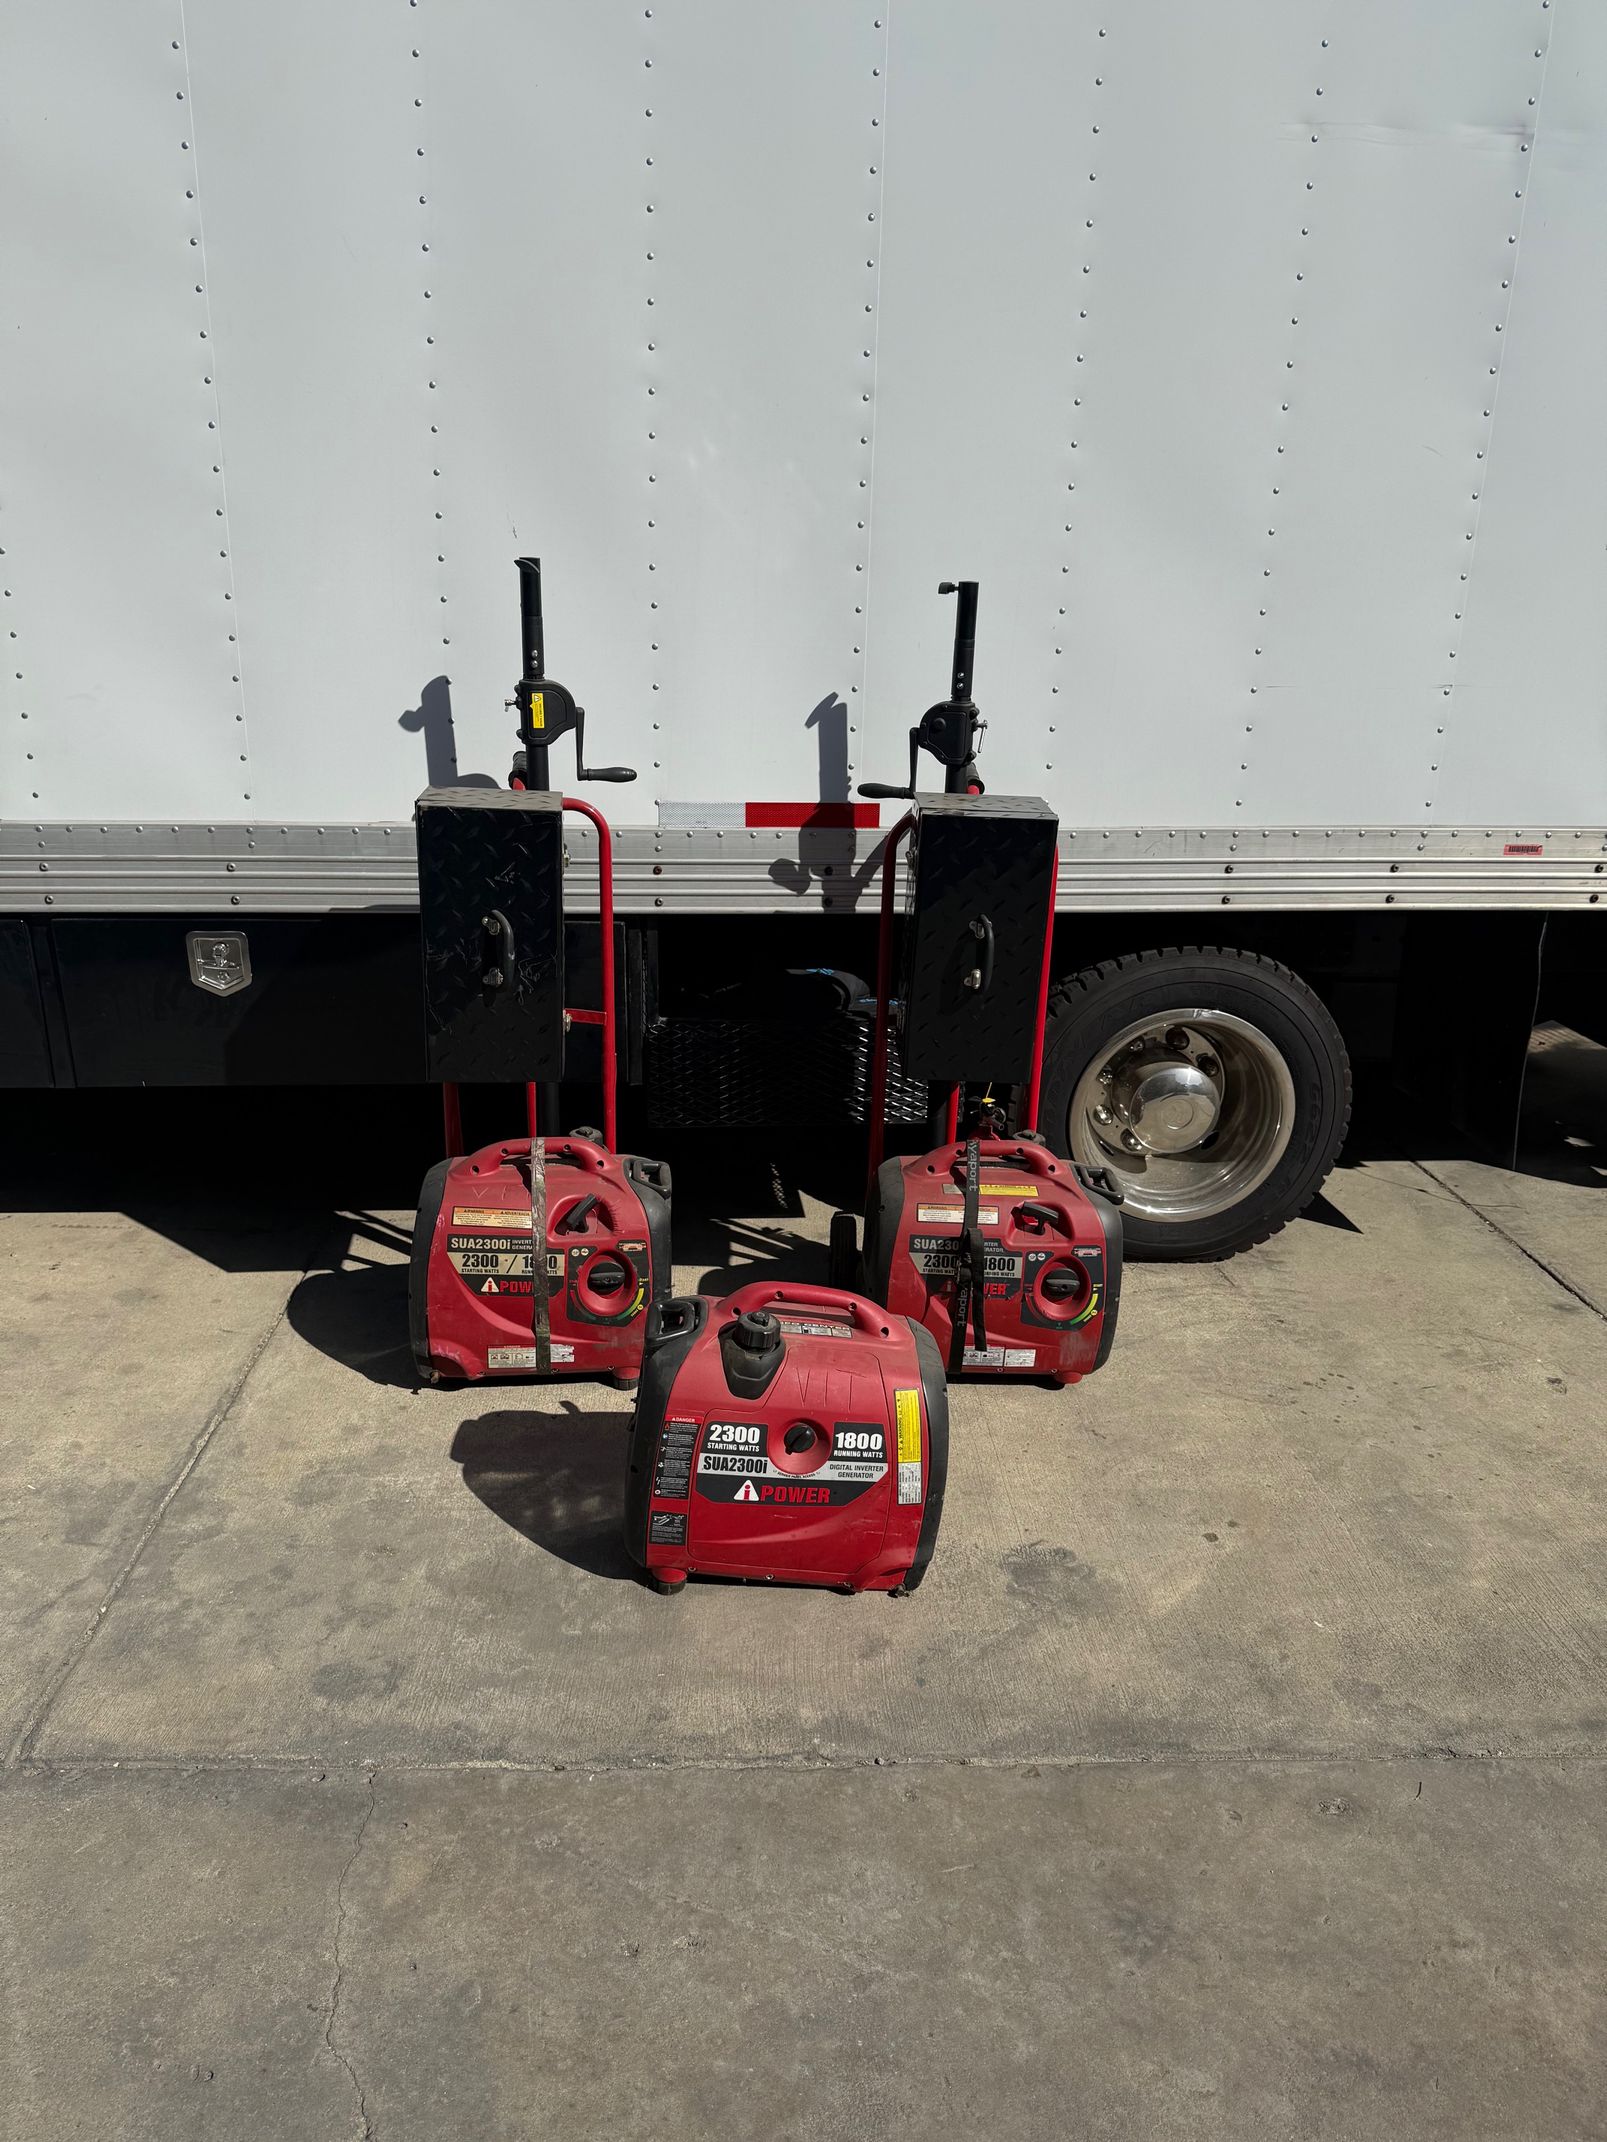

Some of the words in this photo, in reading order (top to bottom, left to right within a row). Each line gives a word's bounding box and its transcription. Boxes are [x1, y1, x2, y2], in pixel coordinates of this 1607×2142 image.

[451, 1238, 511, 1249] SUA2300i
[913, 1239, 960, 1250] SUA230
[462, 1254, 499, 1268] 2300
[522, 1255, 558, 1269] 10
[923, 1254, 959, 1269] 2300
[984, 1256, 1015, 1272] 1800
[499, 1280, 533, 1293] POW
[709, 1424, 760, 1444] 2300
[835, 1432, 883, 1450] 1800
[707, 1442, 738, 1451] STARTING
[738, 1444, 760, 1452] WATTS
[833, 1450, 861, 1458] RUNNING
[862, 1451, 884, 1459] WATTS
[703, 1456, 769, 1474] SUA2300i
[829, 1463, 853, 1471] DIGITAL
[854, 1464, 884, 1472] INVERTER
[760, 1485, 831, 1504] POWER
